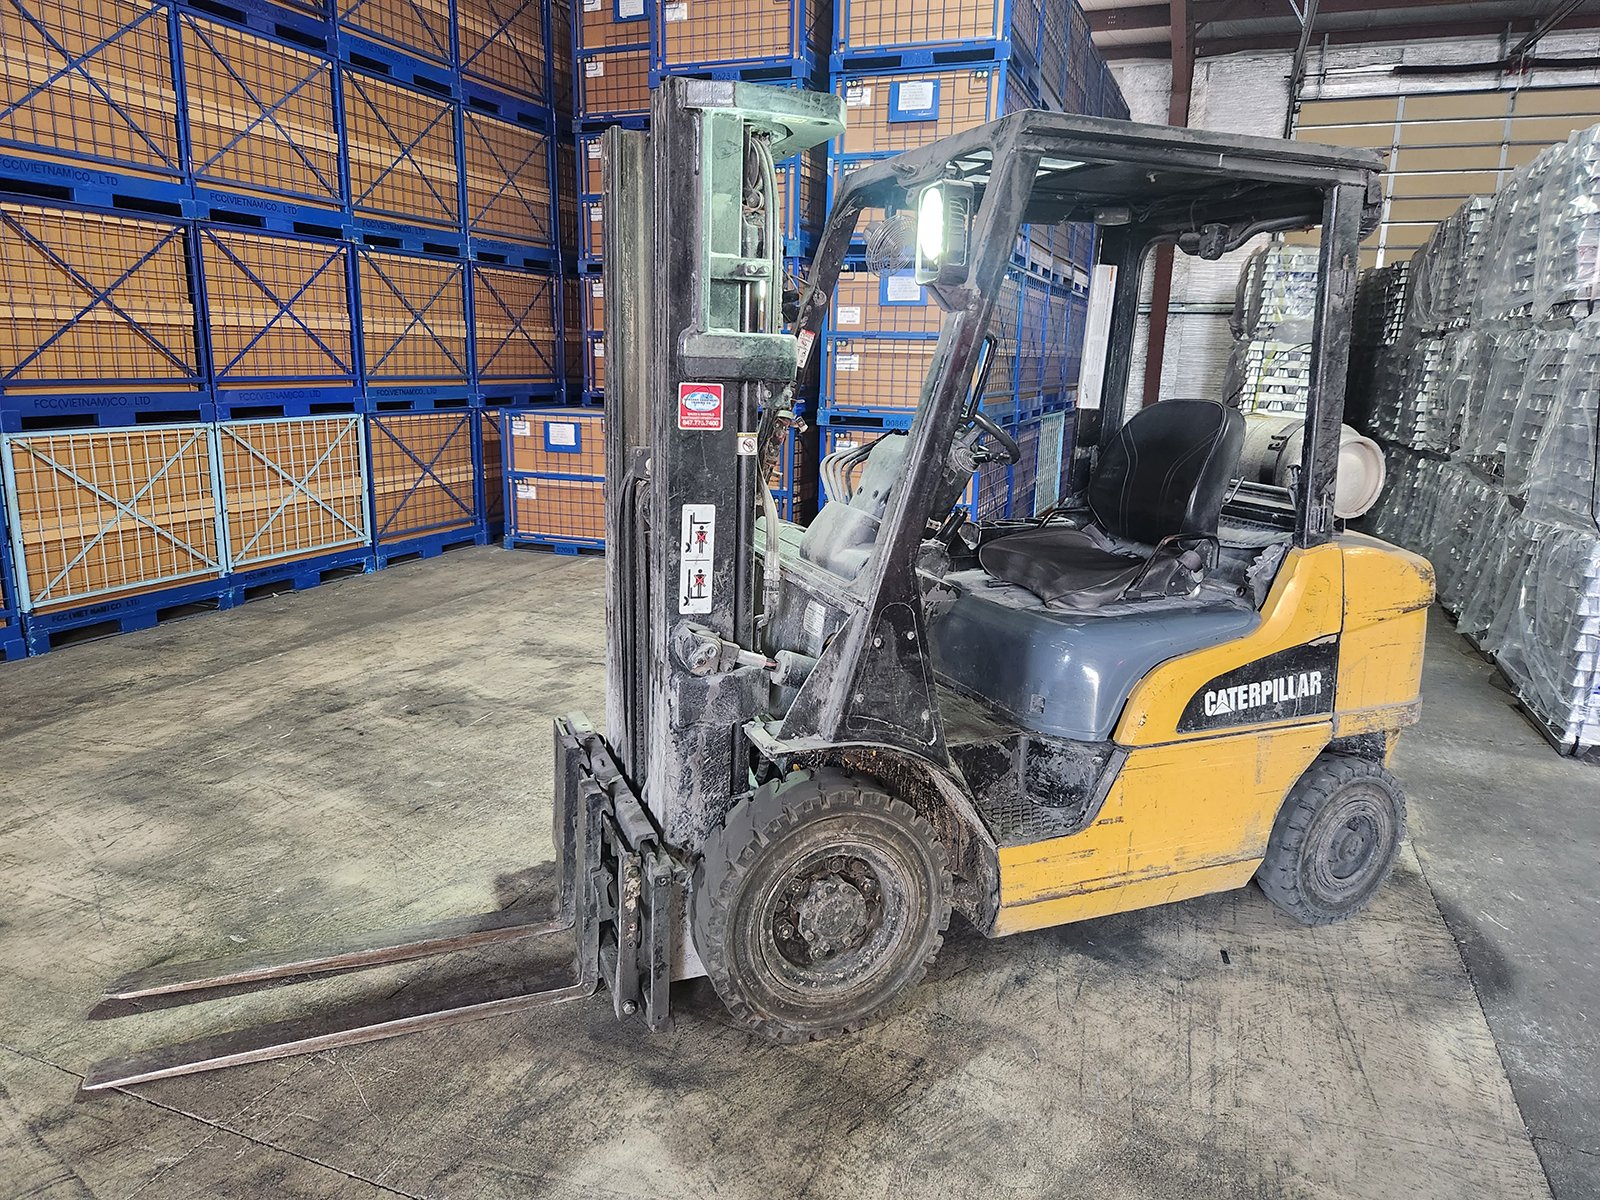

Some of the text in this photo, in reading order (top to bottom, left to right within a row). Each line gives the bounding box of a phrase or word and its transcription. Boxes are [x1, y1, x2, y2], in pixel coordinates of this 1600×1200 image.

[99, 175, 118, 186] LTD
[283, 205, 298, 215] LTD
[134, 395, 151, 406] LTD
[1204, 671, 1322, 717] CATERPILLAR
